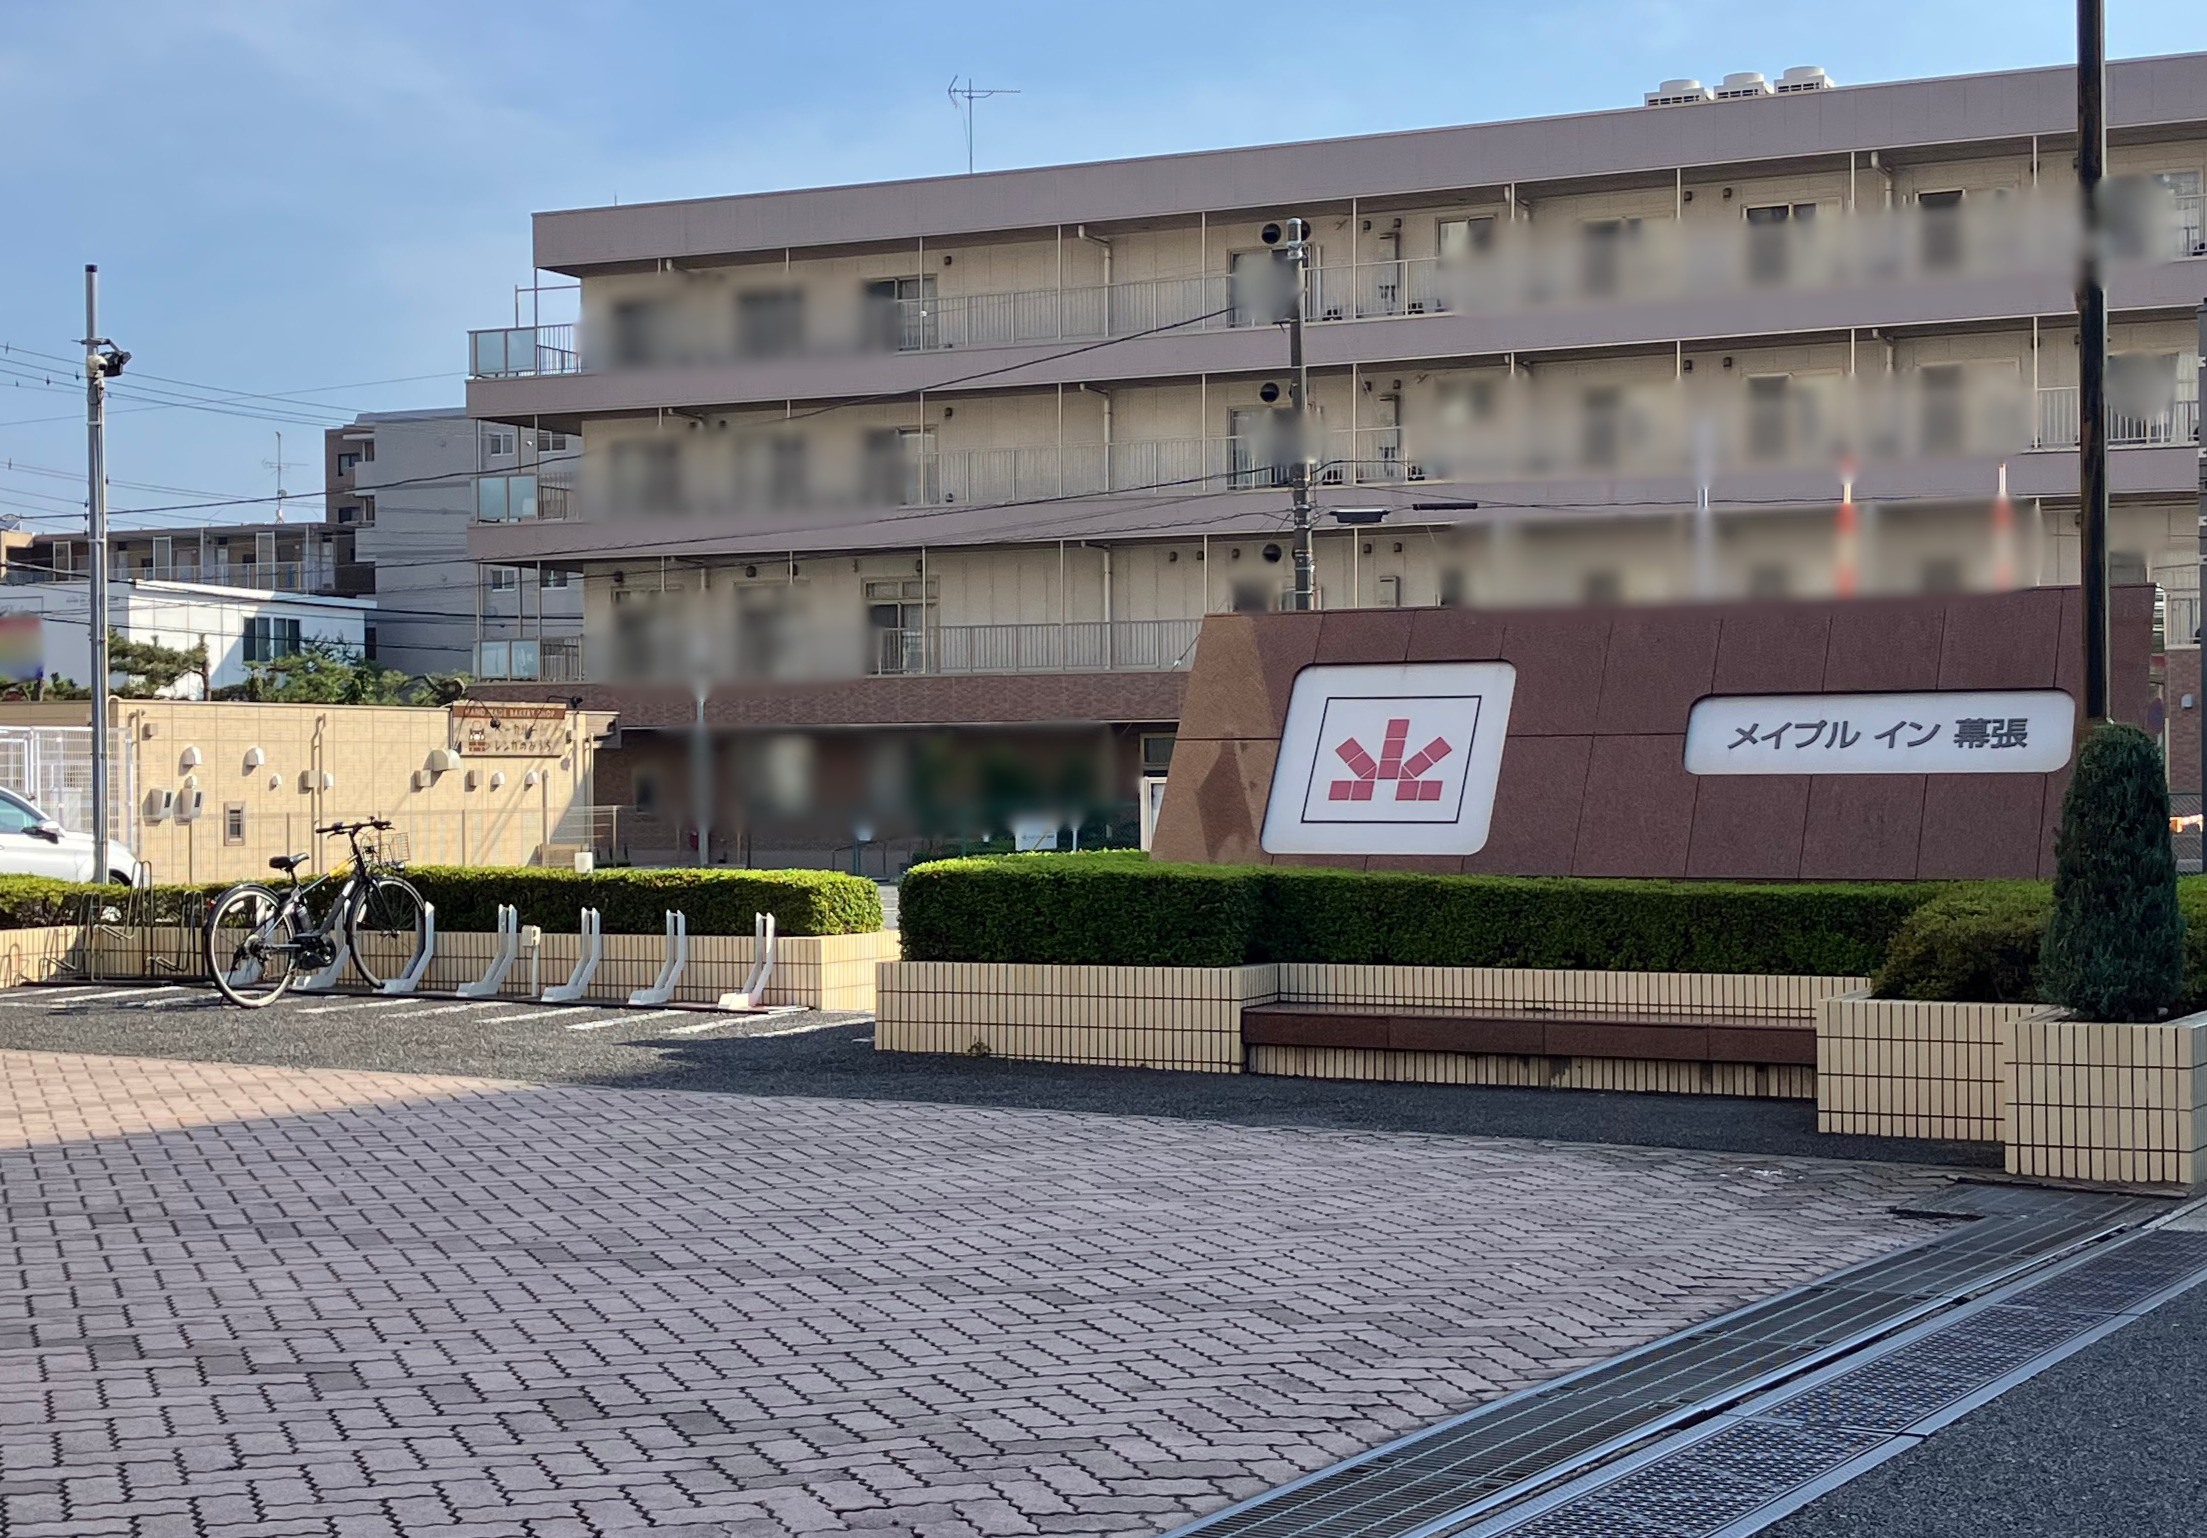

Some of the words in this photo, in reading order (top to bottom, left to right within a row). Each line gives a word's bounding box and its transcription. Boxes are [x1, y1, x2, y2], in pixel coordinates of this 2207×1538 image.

[509, 710, 535, 718] BAKERY
[1727, 720, 1861, 750] メイプル
[1874, 720, 1941, 749] イン
[1954, 717, 2029, 749] 幕張
